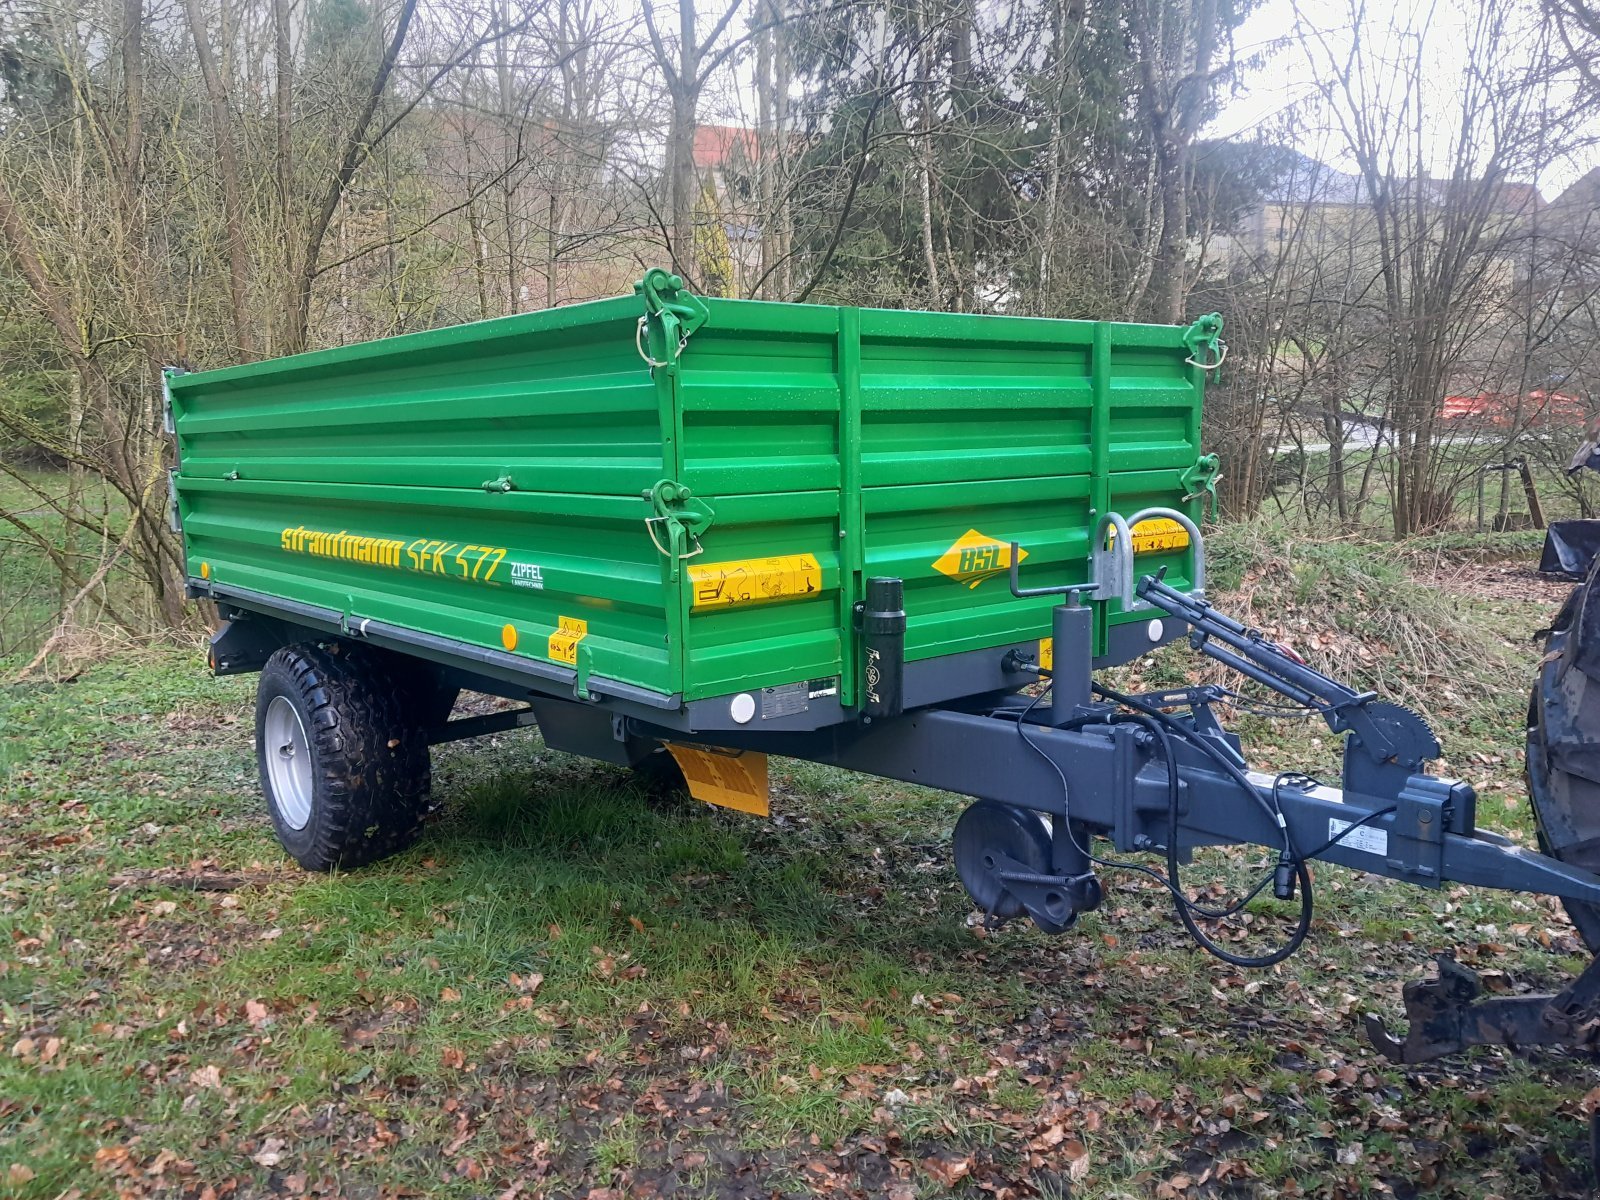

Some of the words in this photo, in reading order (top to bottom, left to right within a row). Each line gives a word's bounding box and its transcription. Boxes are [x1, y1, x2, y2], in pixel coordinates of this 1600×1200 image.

[281, 526, 406, 566] strautmann
[958, 546, 1004, 573] BSL
[511, 561, 544, 580] ZIPFEL
